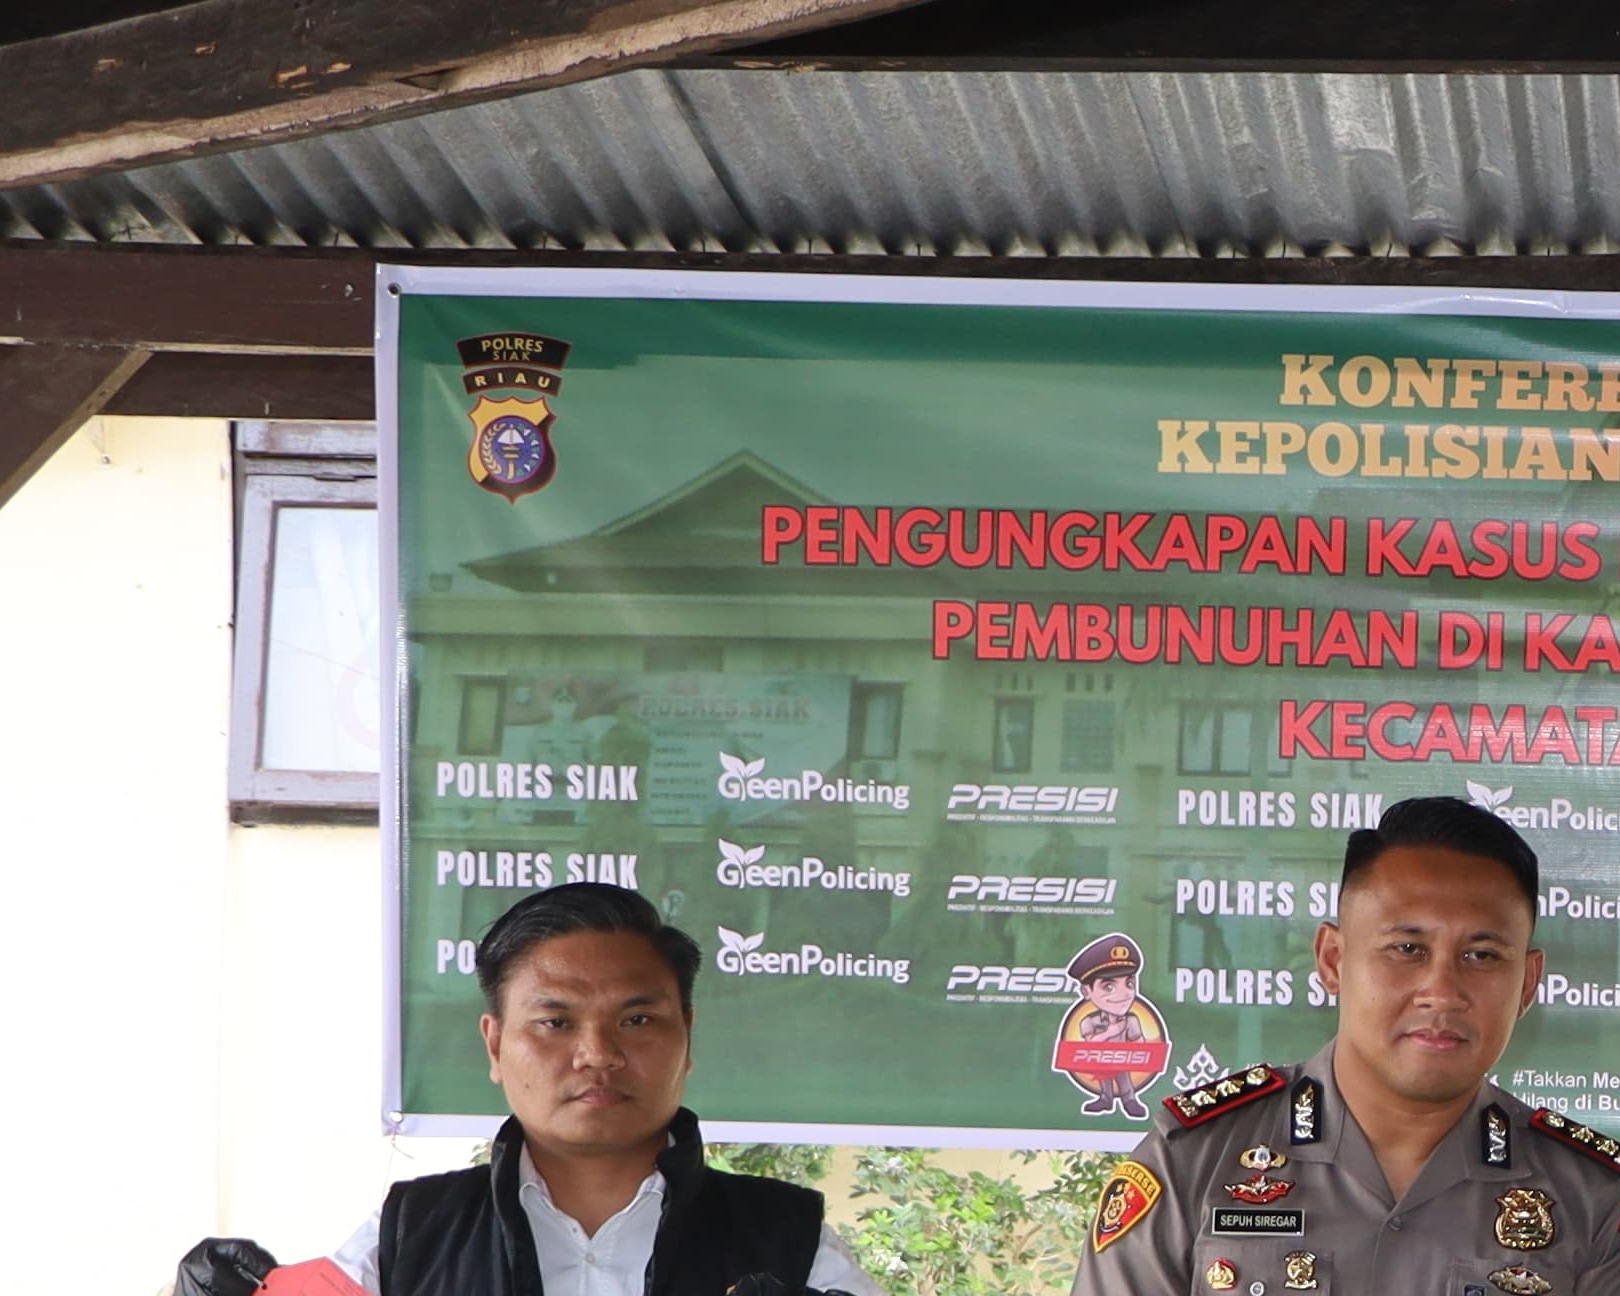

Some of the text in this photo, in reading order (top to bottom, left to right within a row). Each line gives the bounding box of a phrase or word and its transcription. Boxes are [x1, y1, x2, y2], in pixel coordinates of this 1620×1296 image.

[481, 338, 544, 352] POLRES
[493, 351, 531, 361] SIAK
[474, 372, 551, 388] RIAU
[761, 504, 1348, 576] PENGUNGKAPAN
[1365, 517, 1602, 583] KASUS
[932, 600, 1419, 672] PEMBUNUHAN
[1437, 611, 1502, 673] DI
[436, 761, 553, 799] POLRES
[566, 764, 638, 801] SIAK
[947, 784, 1119, 813] PRESISI
[1178, 789, 1383, 829] POLRES SIAK
[436, 850, 639, 890] POLRES SIAK
[947, 874, 1118, 904] PRESISI
[1176, 879, 1339, 918] POLRES SI
[947, 966, 1079, 992] PRES
[1176, 969, 1293, 1006] POLRES
[1073, 1049, 1151, 1065] PRESISI
[1512, 1070, 1587, 1089] #Takkan
[1574, 1094, 1592, 1111] di
[1220, 1213, 1297, 1228] SEPUH SIREGAR
